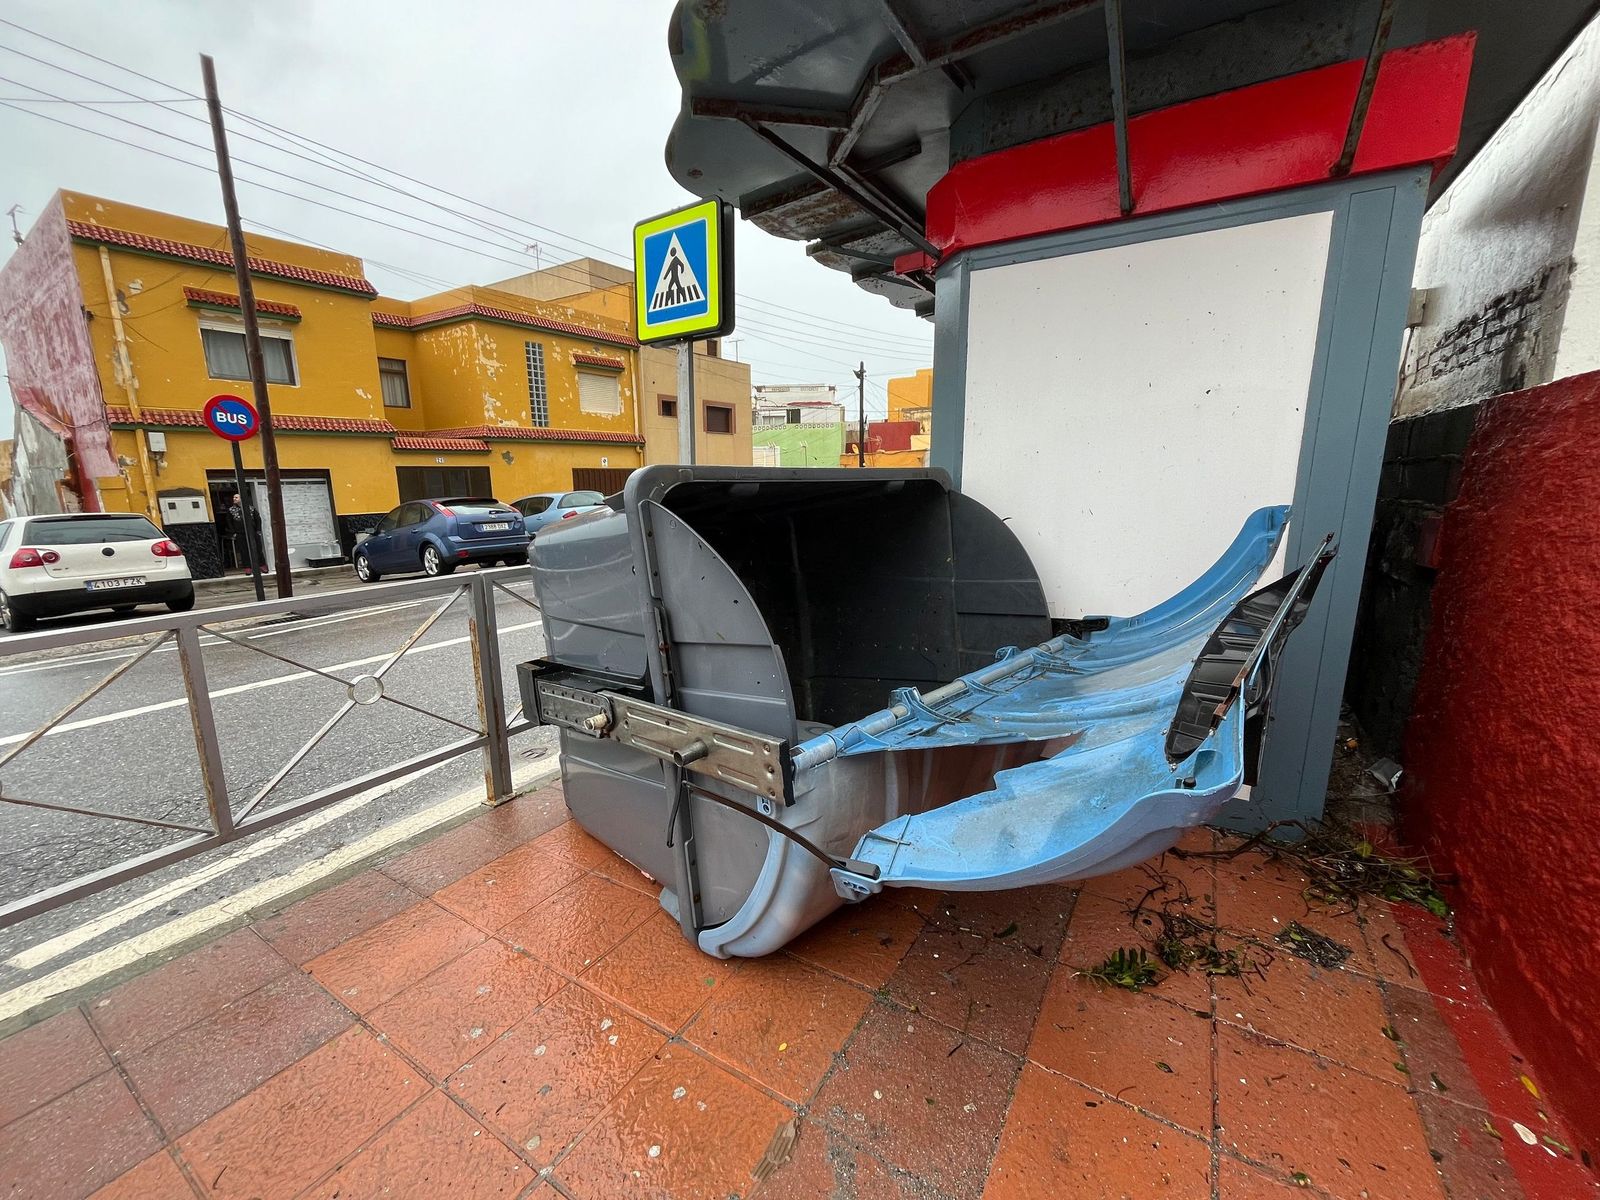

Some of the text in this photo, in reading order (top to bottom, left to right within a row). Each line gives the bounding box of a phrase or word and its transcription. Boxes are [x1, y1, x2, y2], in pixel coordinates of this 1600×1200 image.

[216, 411, 248, 425] BUS
[94, 577, 143, 589] 4103 FZK
